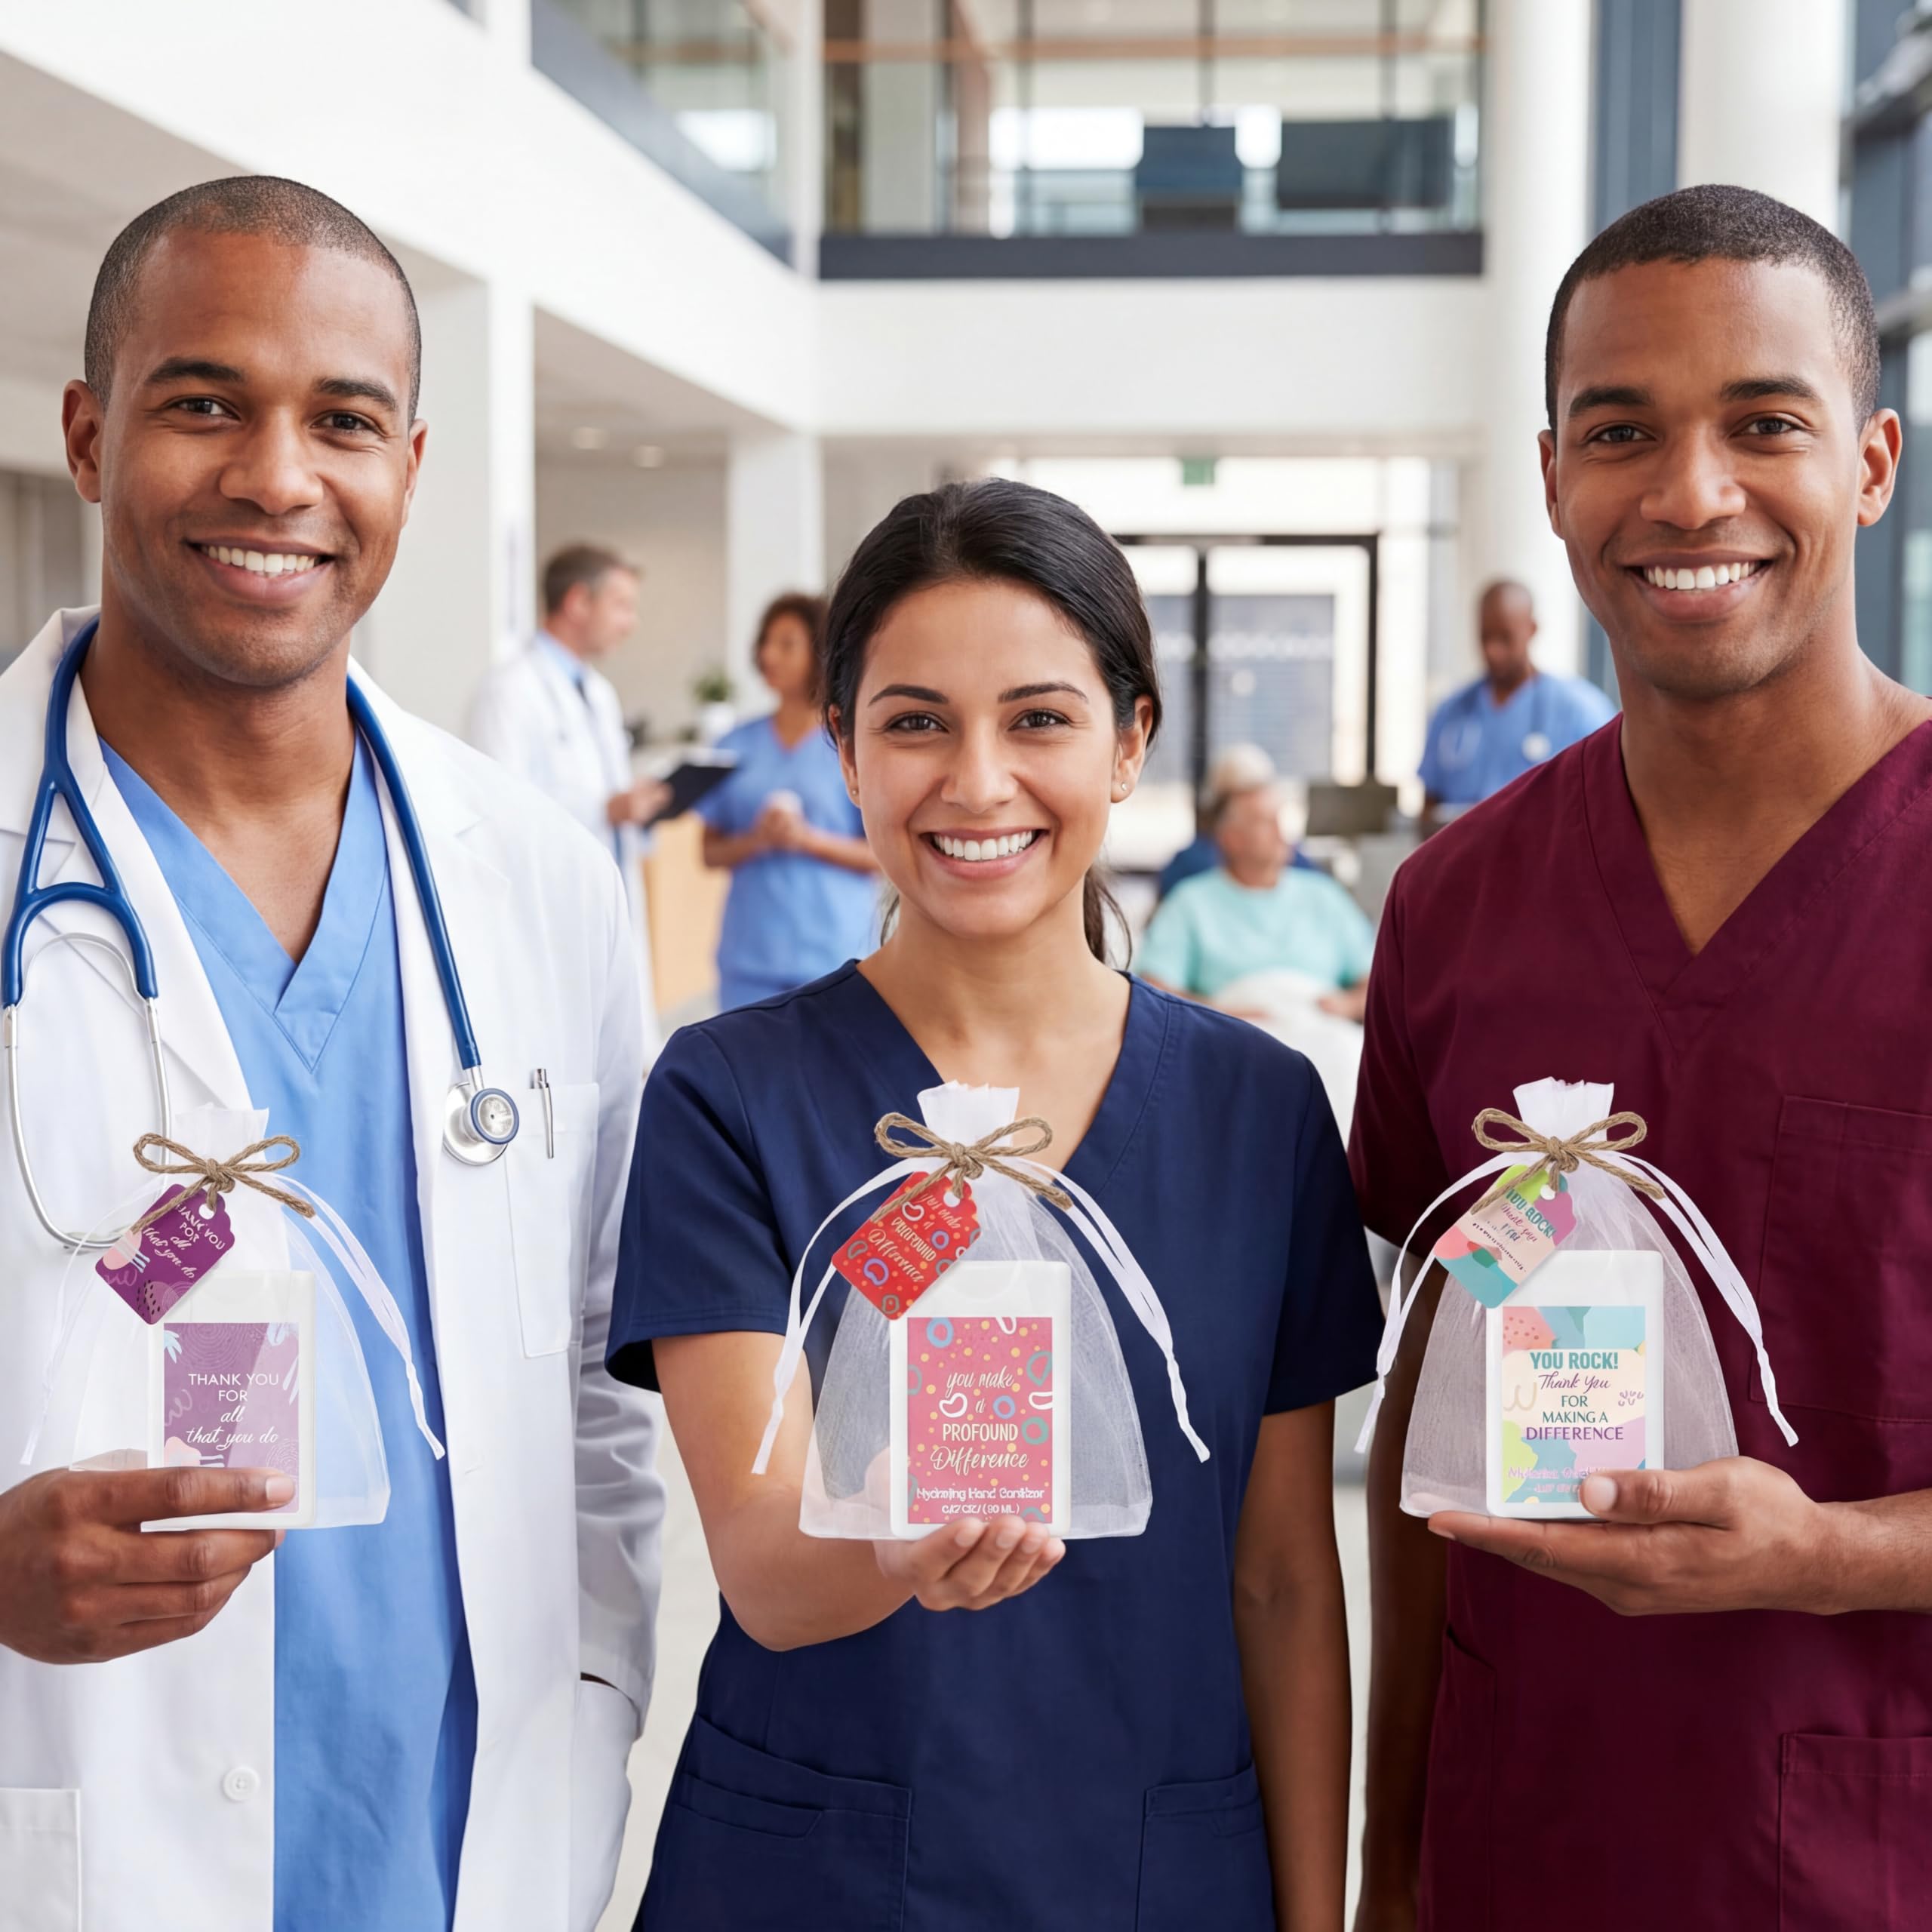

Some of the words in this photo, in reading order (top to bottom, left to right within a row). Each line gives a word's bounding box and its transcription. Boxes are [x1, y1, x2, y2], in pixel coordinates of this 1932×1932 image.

[1530, 1352, 1563, 1369] YOU
[1569, 1352, 1618, 1370] ROCK!
[188, 1374, 241, 1386] THANK
[247, 1374, 278, 1386] YOU
[946, 1371, 974, 1398] you
[979, 1365, 1014, 1389] make
[1538, 1371, 1580, 1390] Thank
[219, 1389, 248, 1401] FOR
[1561, 1395, 1588, 1407] FOR
[220, 1405, 245, 1423] all
[976, 1398, 986, 1414] a
[1543, 1411, 1595, 1423] MAKING
[1598, 1411, 1608, 1423] A
[186, 1426, 223, 1444] that
[216, 1432, 254, 1451] you
[259, 1426, 278, 1444] do
[943, 1423, 1018, 1441] PROFOUND
[1526, 1426, 1624, 1441] DIFFERENCE
[930, 1446, 1029, 1475] Difference
